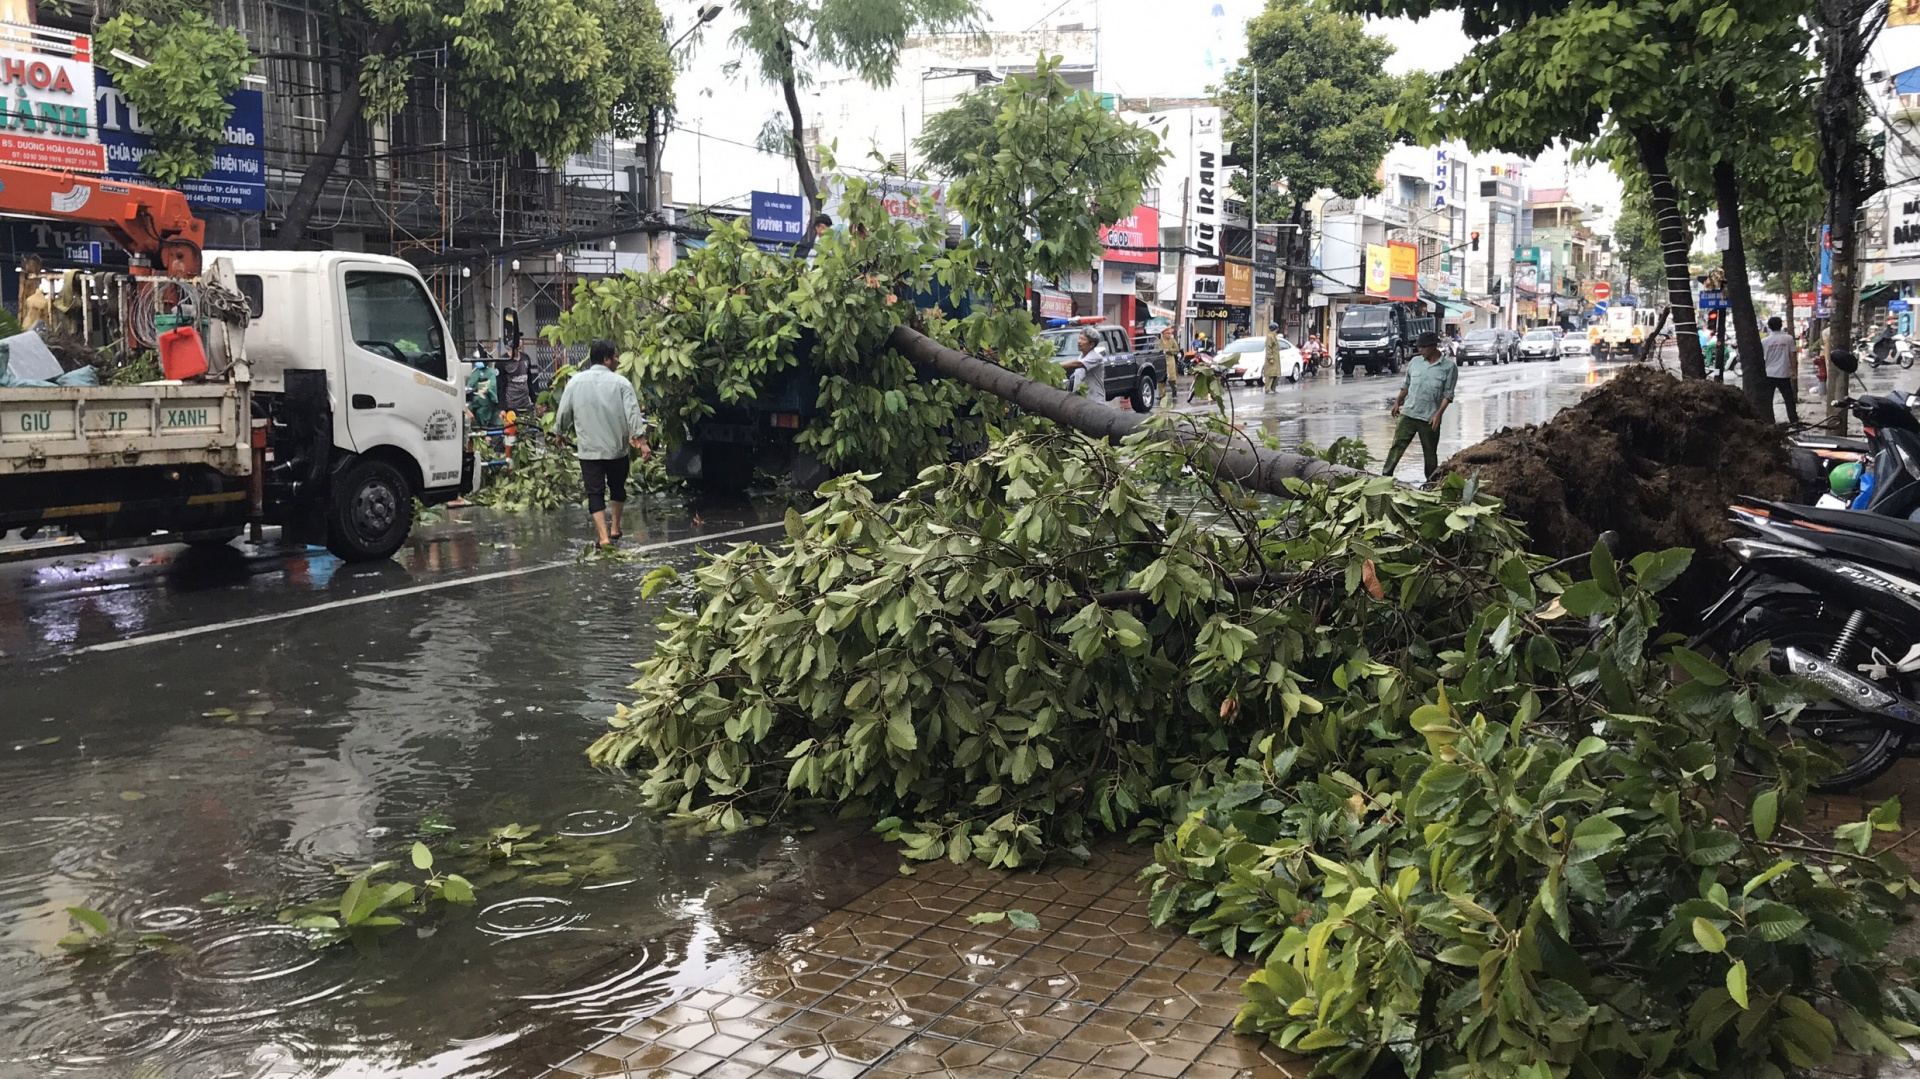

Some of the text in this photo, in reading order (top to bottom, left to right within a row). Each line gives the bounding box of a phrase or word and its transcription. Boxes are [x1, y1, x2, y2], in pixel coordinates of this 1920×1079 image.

[0, 57, 75, 94] HOA
[219, 125, 255, 146] obile
[66, 147, 85, 156] GIAO
[785, 220, 801, 234] THƠ
[67, 245, 90, 259] Tuấn
[21, 409, 207, 431] GIỮ TP XANH
